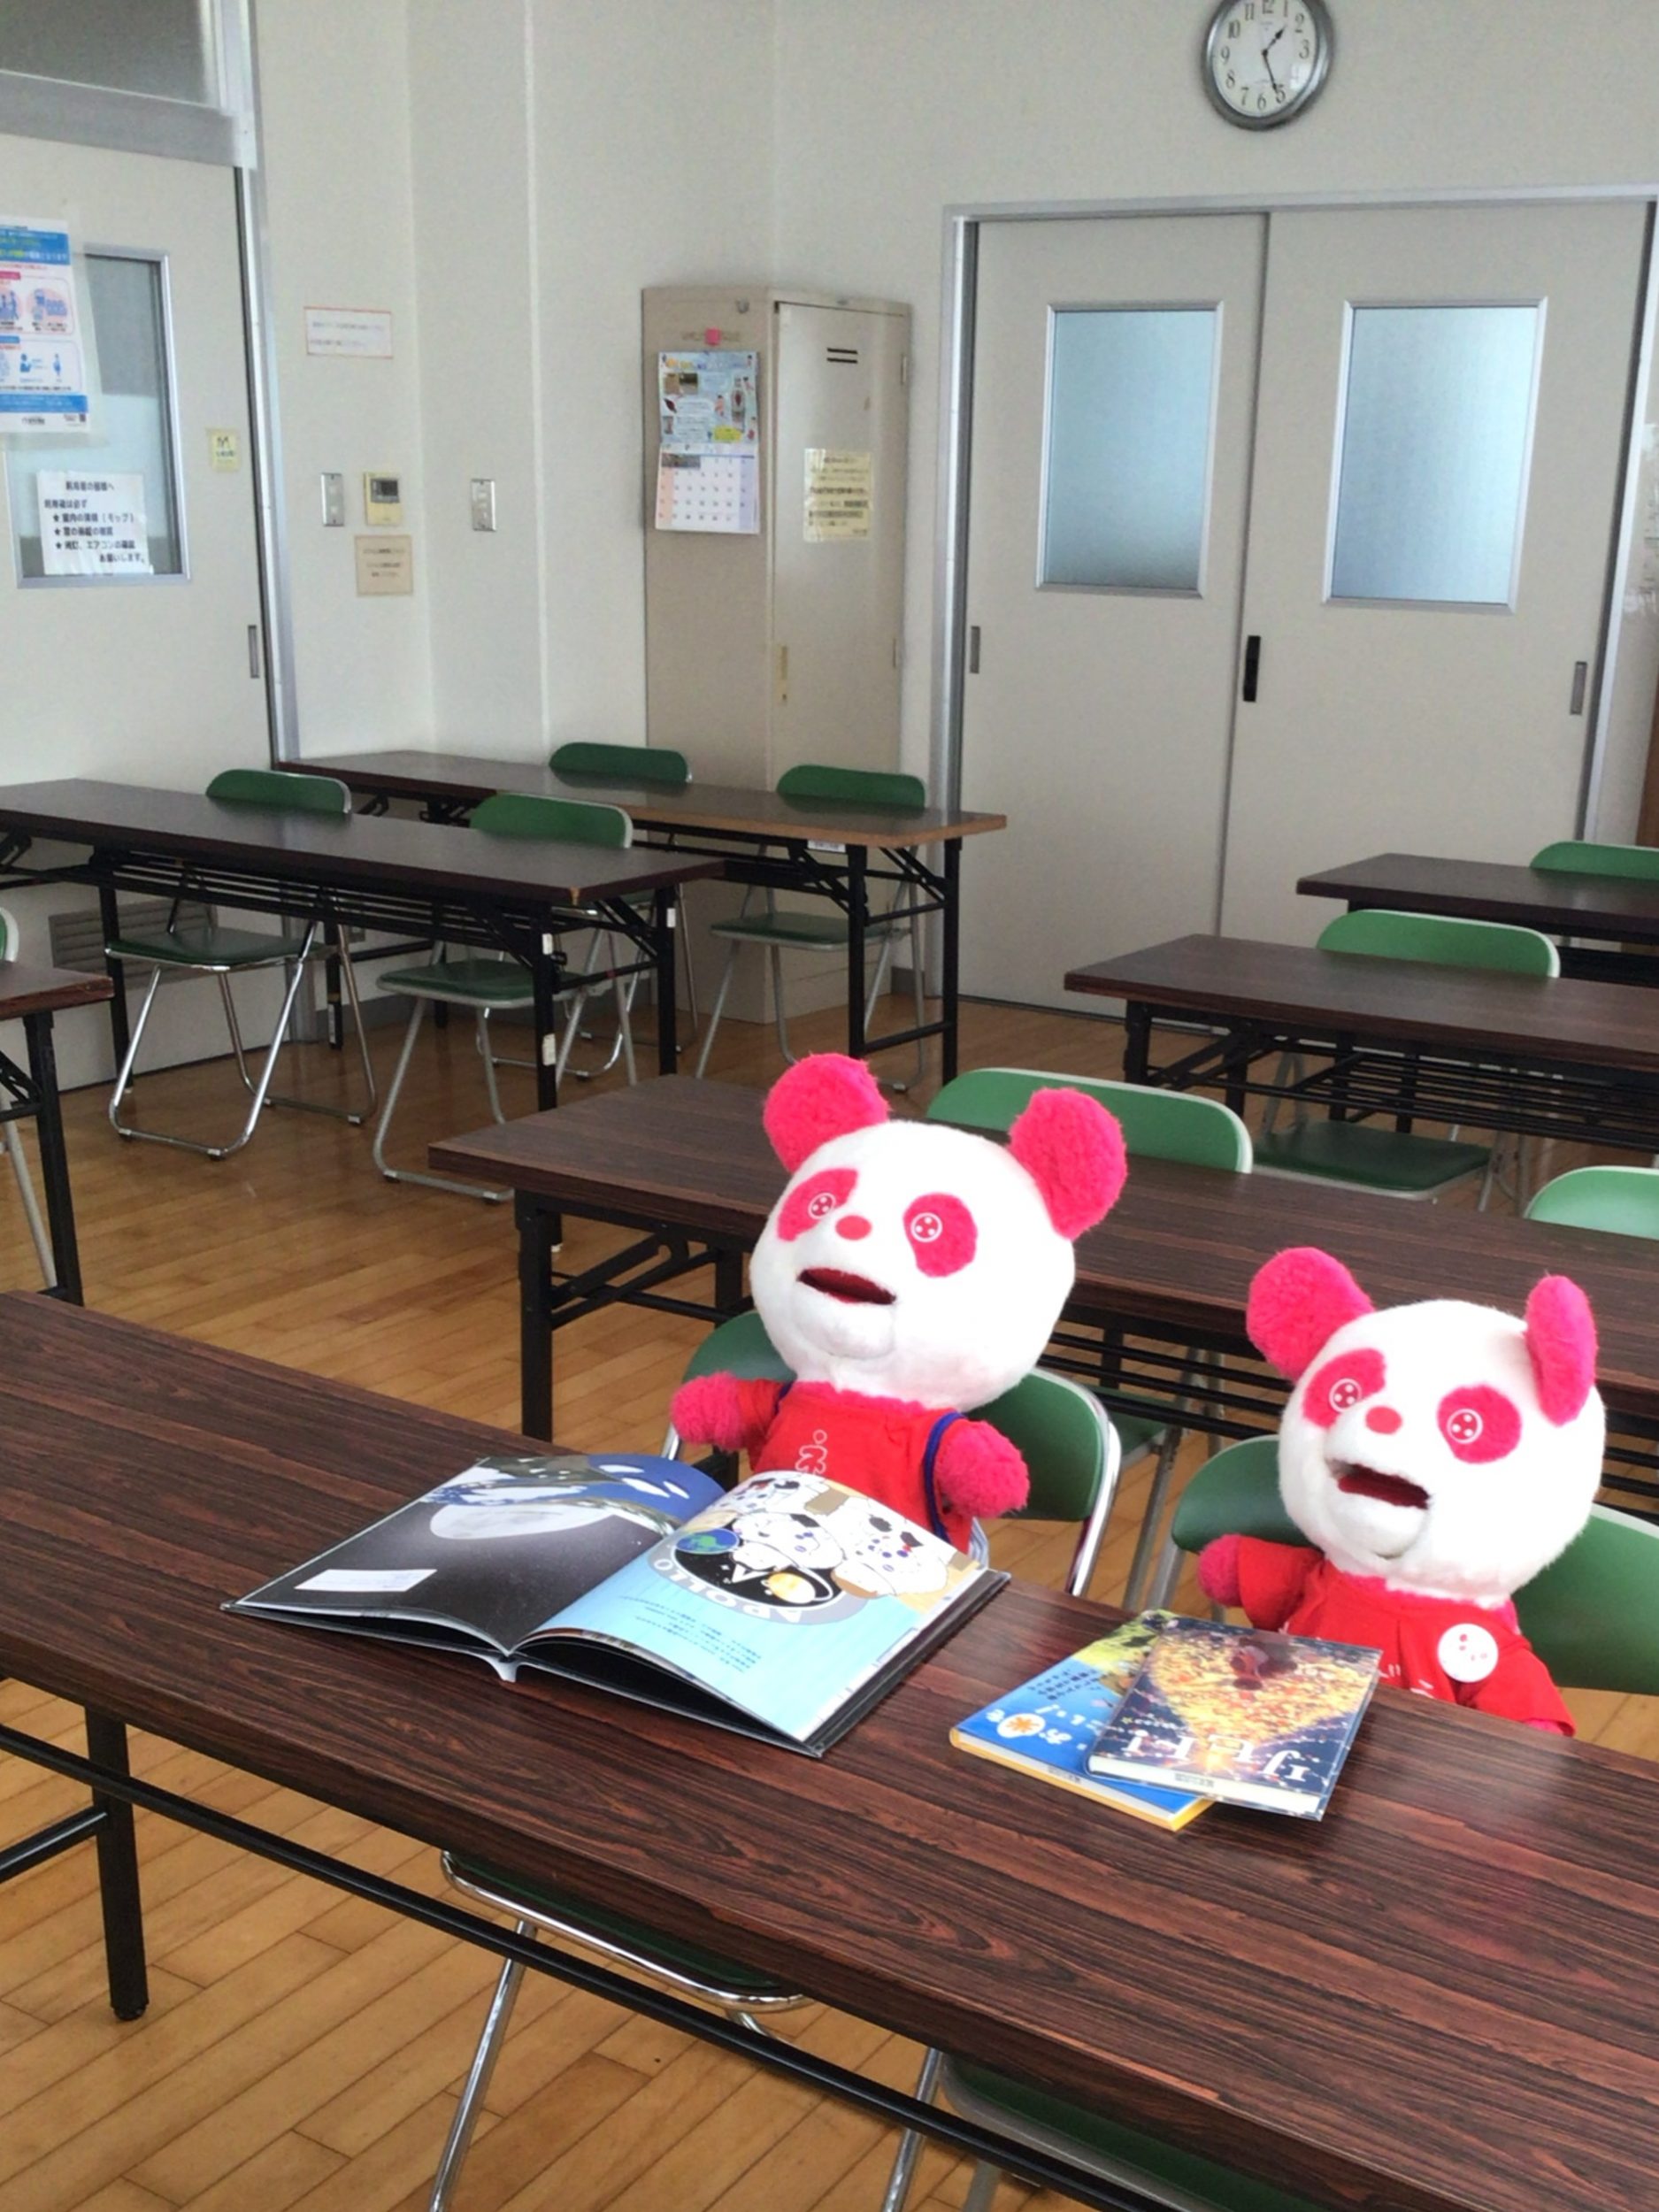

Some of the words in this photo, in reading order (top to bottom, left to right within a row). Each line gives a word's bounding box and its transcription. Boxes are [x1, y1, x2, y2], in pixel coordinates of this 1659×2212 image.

[1245, 3, 1256, 21] 11
[1262, 0, 1275, 15] 12
[1228, 20, 1240, 39] 10
[1294, 13, 1305, 34] 2
[1220, 46, 1231, 65] 9
[1299, 39, 1310, 59] 3
[1225, 70, 1236, 89] 8
[1240, 87, 1249, 106] 7
[1257, 92, 1267, 111] 6
[1275, 84, 1286, 104] 5
[653, 1558, 803, 1624] APOLLO
